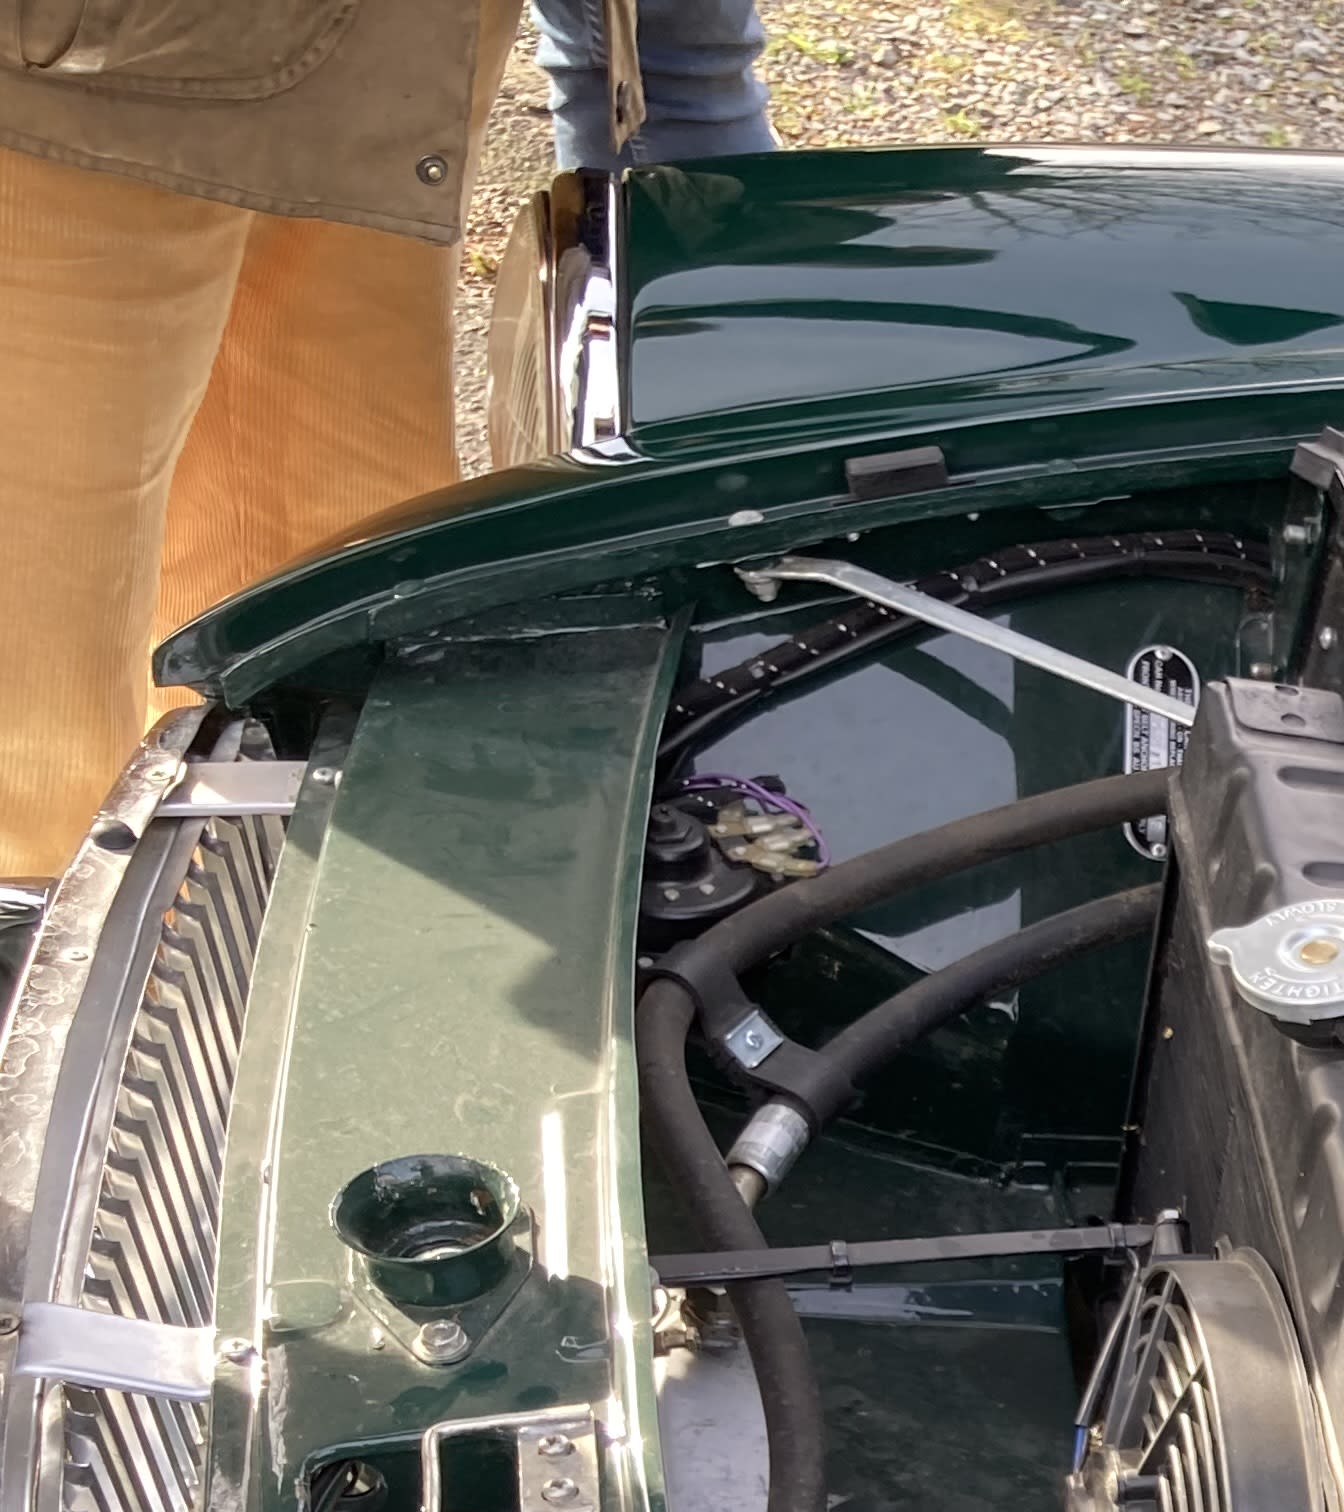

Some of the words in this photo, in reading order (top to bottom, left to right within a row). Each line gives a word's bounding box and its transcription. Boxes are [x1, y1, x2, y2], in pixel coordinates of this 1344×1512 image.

[1141, 660, 1151, 687] FRON
[1141, 737, 1150, 772] ANCHO
[1264, 901, 1337, 928] SLOWLY
